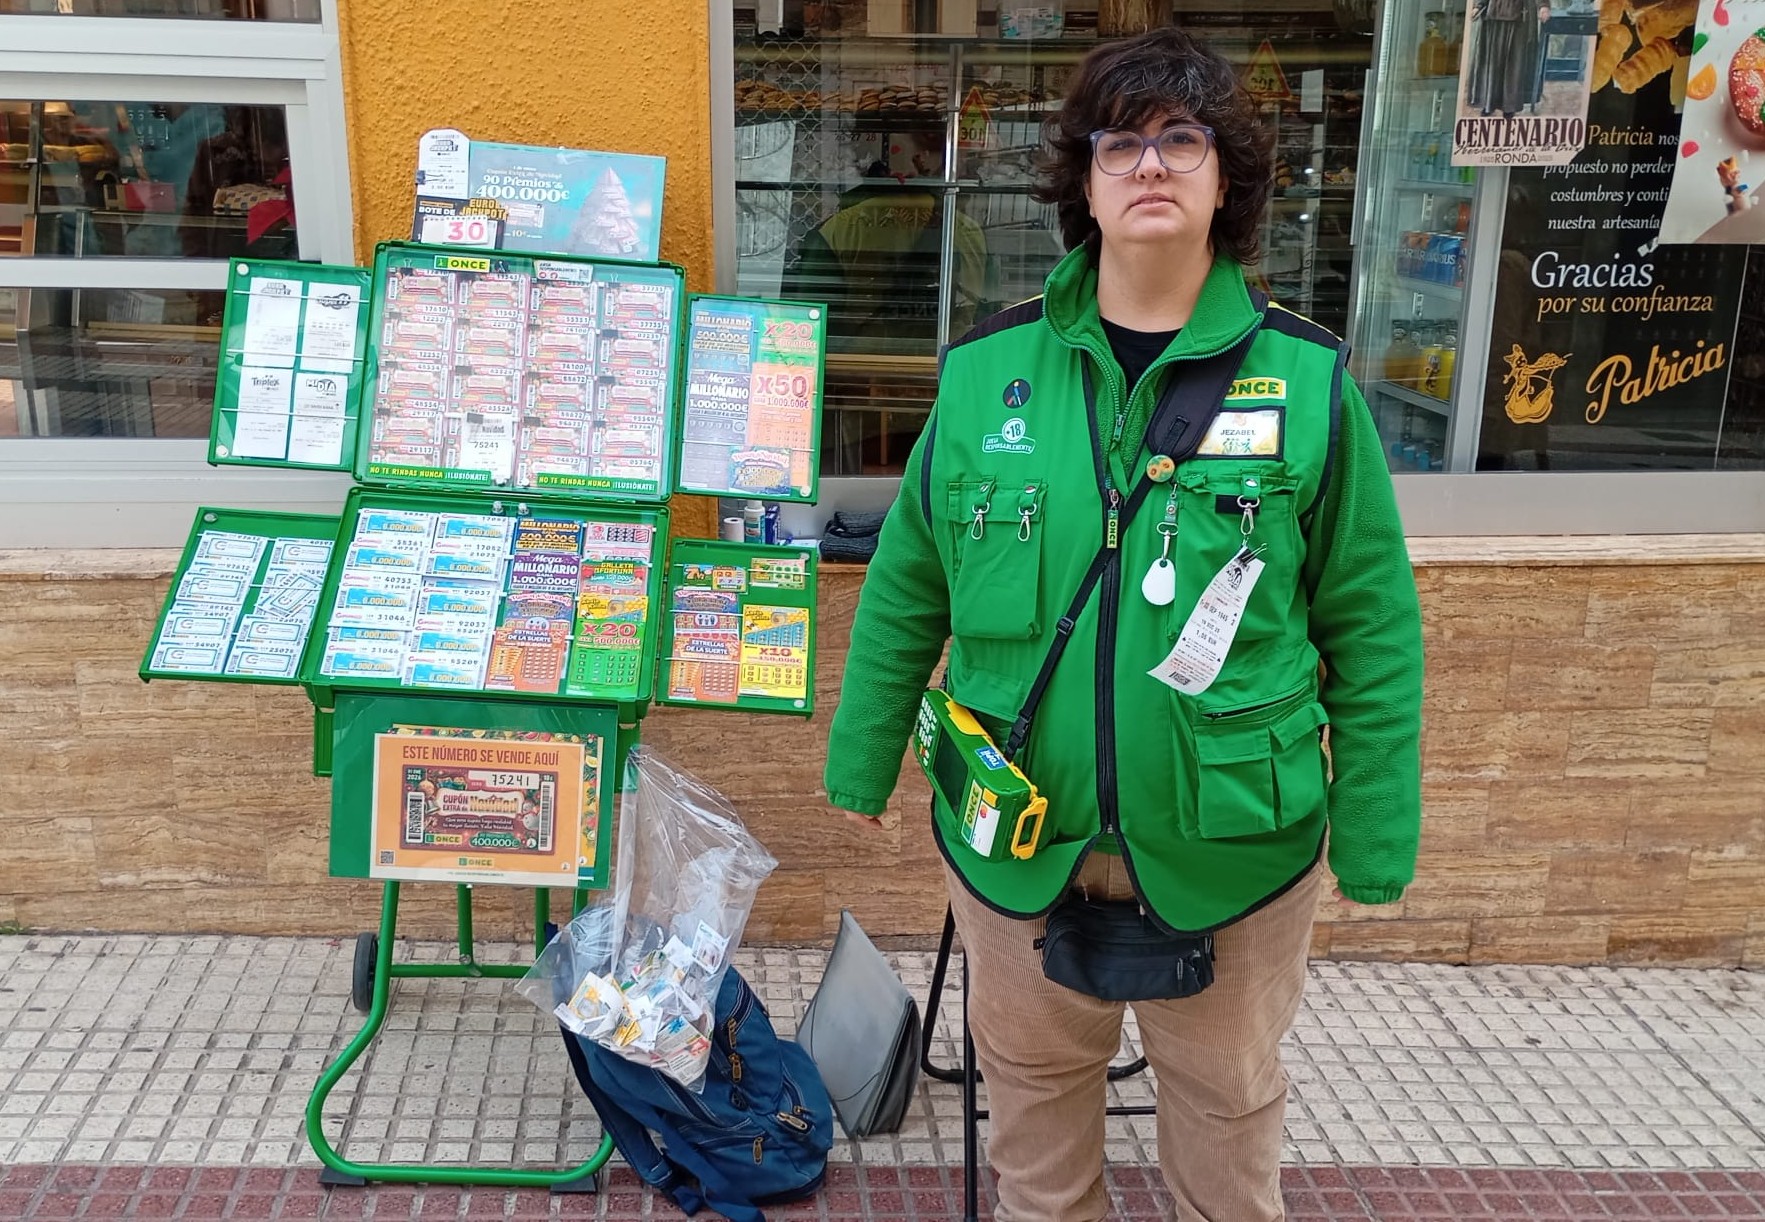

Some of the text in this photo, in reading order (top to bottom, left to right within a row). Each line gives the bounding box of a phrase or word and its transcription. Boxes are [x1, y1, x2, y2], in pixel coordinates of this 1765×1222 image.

[1455, 118, 1583, 148] CENTENARIO
[1588, 124, 1654, 146] Patricia
[1495, 153, 1538, 164] RONDA
[1543, 155, 1675, 180] propuesto no perder
[483, 174, 500, 185] 90
[475, 183, 570, 203] 400.000€
[1550, 184, 1623, 202] costumbres
[1624, 189, 1634, 206] y
[418, 206, 456, 217] BOTE DE
[1548, 213, 1660, 231] nuestra artesanía
[448, 221, 485, 240] 30
[450, 259, 487, 270] ONCE
[1531, 251, 1654, 289] Gracias
[1537, 285, 1713, 322] por su confianza
[1227, 381, 1280, 396] ONCE
[1585, 339, 1726, 425] Patricia
[690, 383, 749, 399] MILLONARIO
[690, 399, 749, 412] 1.000.000€
[474, 441, 499, 449] 75241
[392, 468, 418, 476] RINDAS
[419, 470, 443, 478] NUNCA
[538, 475, 549, 483] NO
[560, 477, 586, 486] RINDAS
[587, 479, 611, 488] NUNCA
[519, 521, 580, 532] MILLONARIO
[519, 532, 577, 543] 500.000€
[513, 562, 578, 574] MILLONARIO
[512, 575, 577, 586] 1.000.000€
[691, 639, 726, 648] ESTRELLAS
[403, 745, 559, 766] ESTE NÚMERO SE VENDE AQUÍ
[492, 773, 530, 786] 75241
[443, 793, 468, 804] CUPÓN
[966, 786, 980, 825] ONCE
[471, 837, 521, 847] 400.000€
